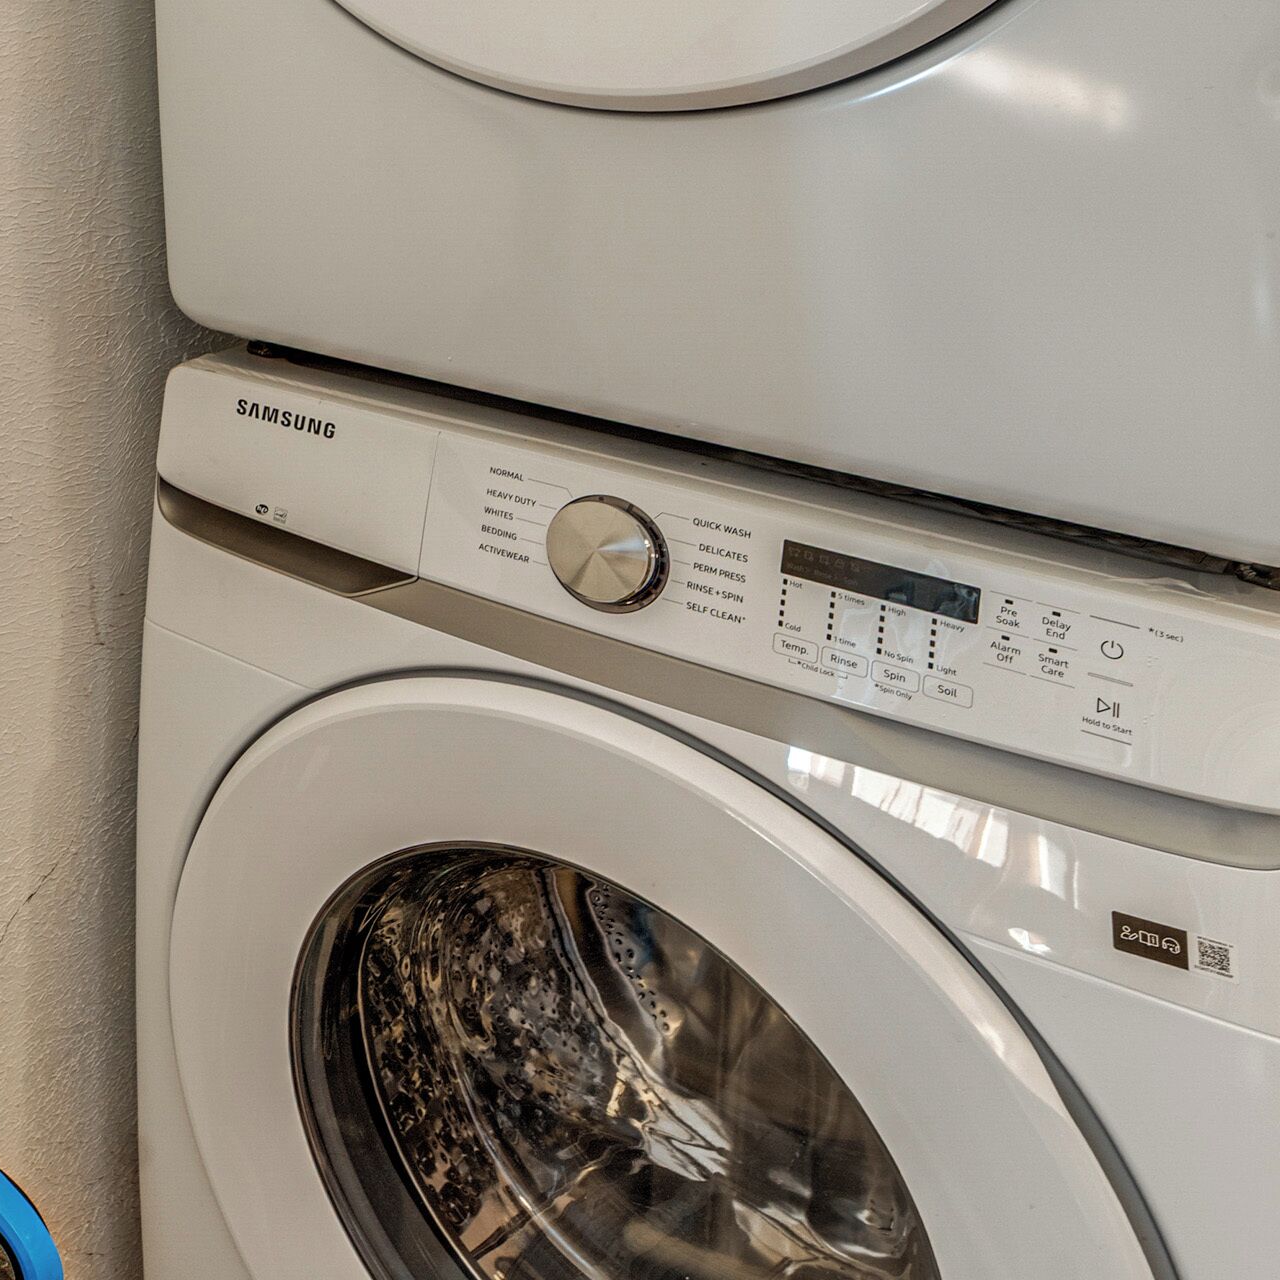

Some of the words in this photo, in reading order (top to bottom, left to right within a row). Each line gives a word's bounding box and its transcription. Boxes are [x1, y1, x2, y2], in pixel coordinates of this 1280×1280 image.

[236, 399, 336, 439] SAMSUNG
[489, 466, 524, 482] NORMAL
[486, 488, 513, 502] HEAVY
[514, 495, 537, 508] DUTY
[483, 506, 514, 521] WHITES
[481, 524, 518, 542] BEDDING
[692, 517, 721, 533] QUICK
[723, 524, 752, 539] WASH
[478, 543, 530, 564] ACTIVEWEAR
[698, 543, 749, 563] DELICATES
[693, 562, 717, 576] PERM
[720, 569, 746, 584] PRESS
[790, 580, 803, 589] Hot
[686, 580, 714, 596] RINSE
[721, 590, 744, 604] SPIN
[838, 592, 843, 600] 5
[844, 594, 865, 606] times
[686, 601, 709, 615] SELF
[888, 606, 906, 617] High
[1000, 606, 1018, 617] Pre
[785, 622, 802, 633] Cold
[940, 619, 965, 633] Heavy
[996, 615, 1020, 628] Soak
[1042, 616, 1071, 632] Delay
[1046, 629, 1065, 640] End
[781, 639, 809, 656] Temp.
[839, 637, 857, 648] time
[990, 641, 1021, 655] Alarm
[830, 654, 858, 669] Rinse
[884, 650, 895, 659] No
[896, 653, 914, 664] Spin
[996, 654, 1014, 664] Off
[1038, 654, 1069, 669] Smart
[819, 667, 835, 677] Lock
[883, 670, 906, 683] Spin
[936, 665, 958, 676] Light
[1041, 665, 1065, 678] Care
[896, 689, 913, 701] Only
[937, 685, 958, 698] Soil
[1082, 716, 1101, 728] Hold
[1102, 722, 1111, 730] to
[1112, 724, 1133, 736] Start
